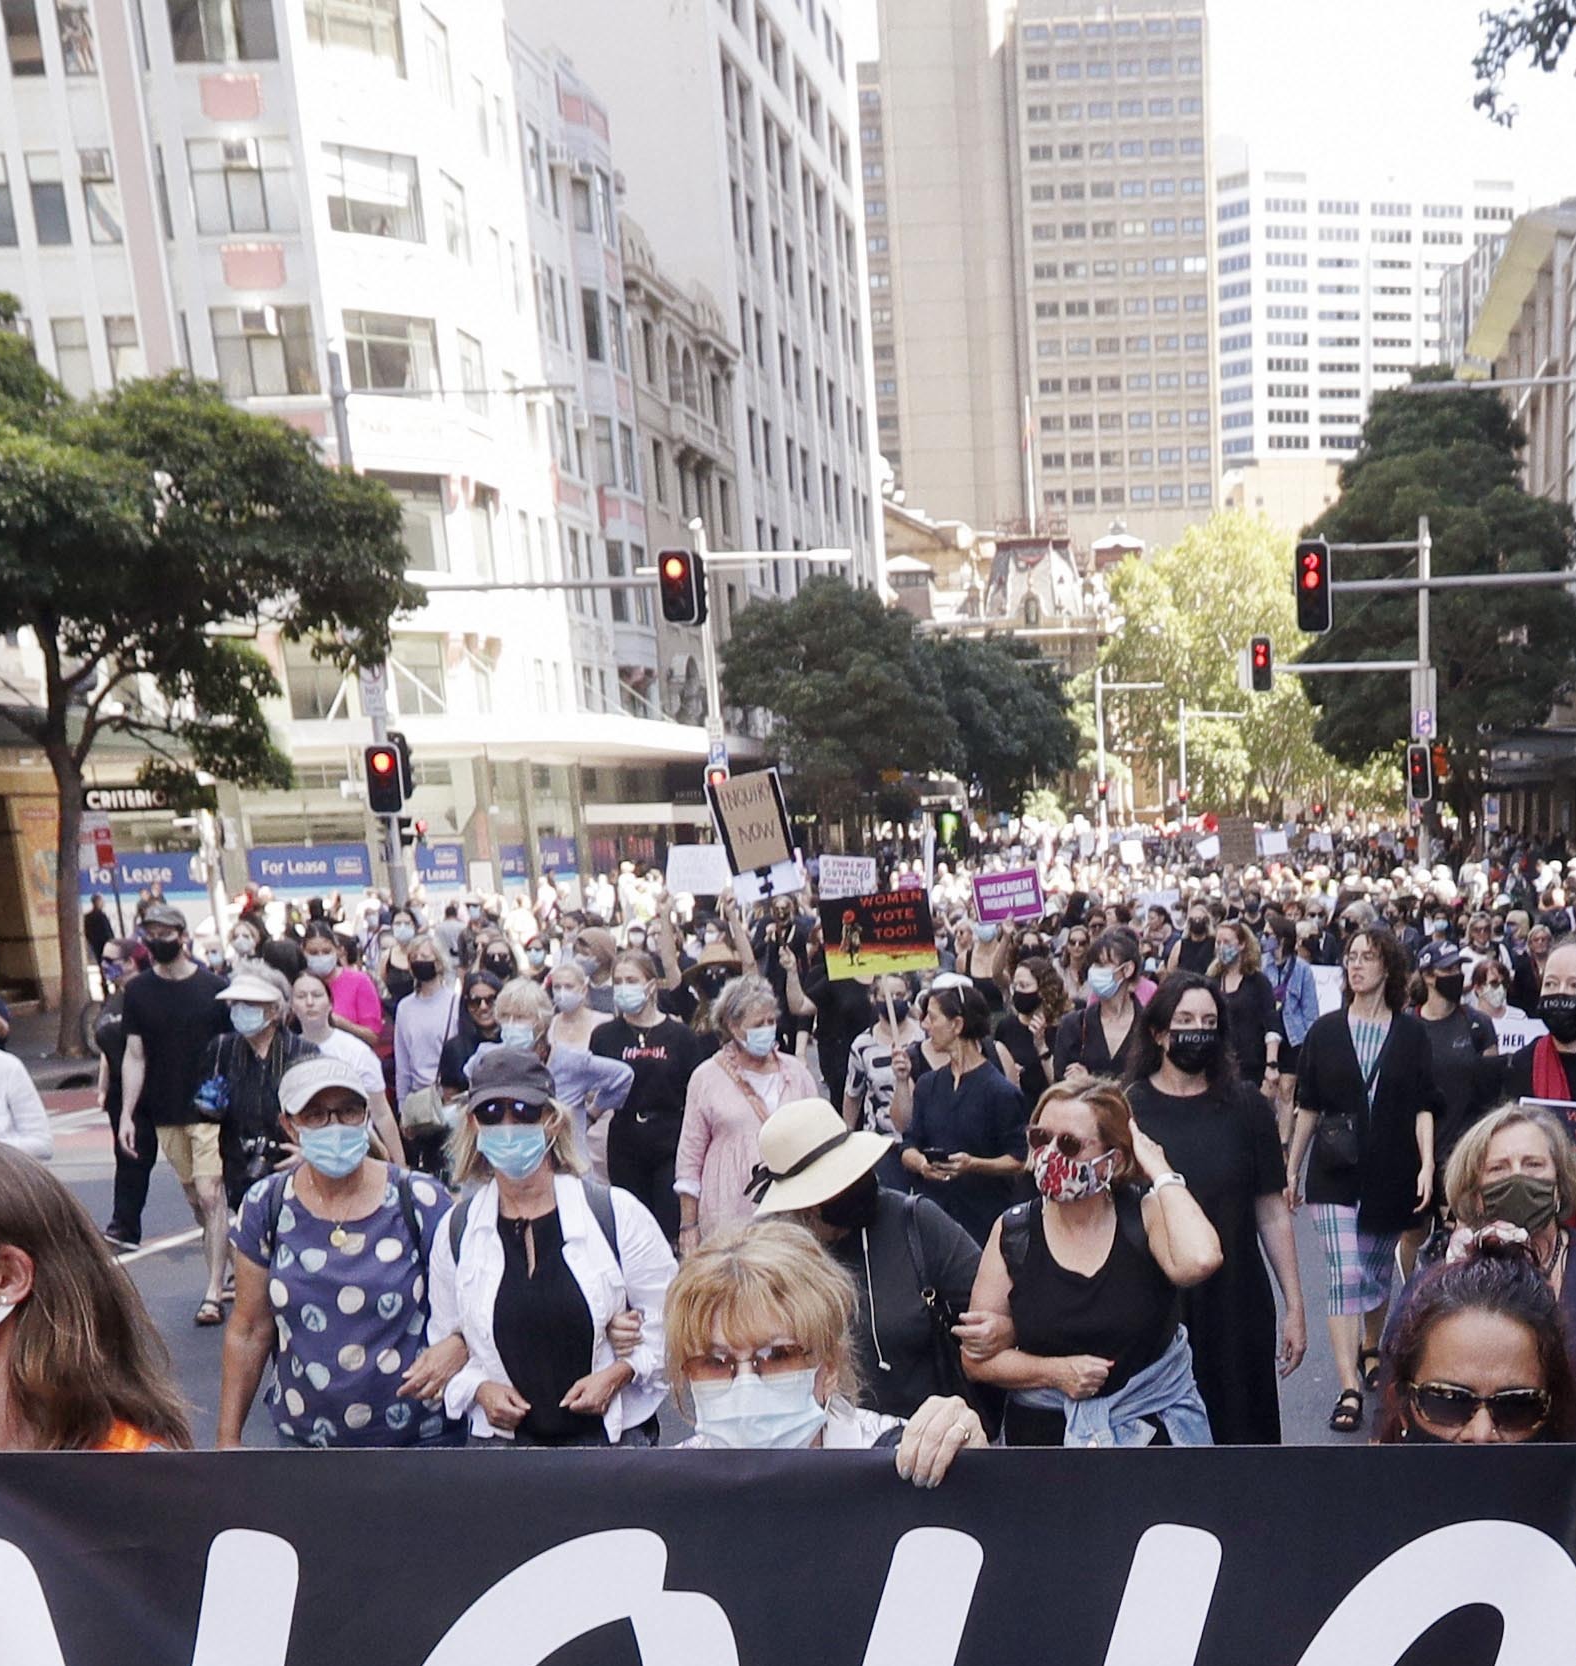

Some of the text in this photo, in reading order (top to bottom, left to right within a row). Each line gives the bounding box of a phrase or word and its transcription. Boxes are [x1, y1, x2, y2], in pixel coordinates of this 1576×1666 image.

[721, 782, 771, 811] INQUIRY
[737, 819, 774, 844] NOW
[122, 867, 173, 885] Lease
[261, 859, 284, 876] For
[288, 858, 327, 875] Lease
[979, 877, 1033, 898] INDEPENDENT
[860, 890, 922, 908] WOMEN
[872, 907, 916, 923] VOTE
[874, 924, 919, 939] TOO!!
[1503, 1033, 1525, 1047] HER
